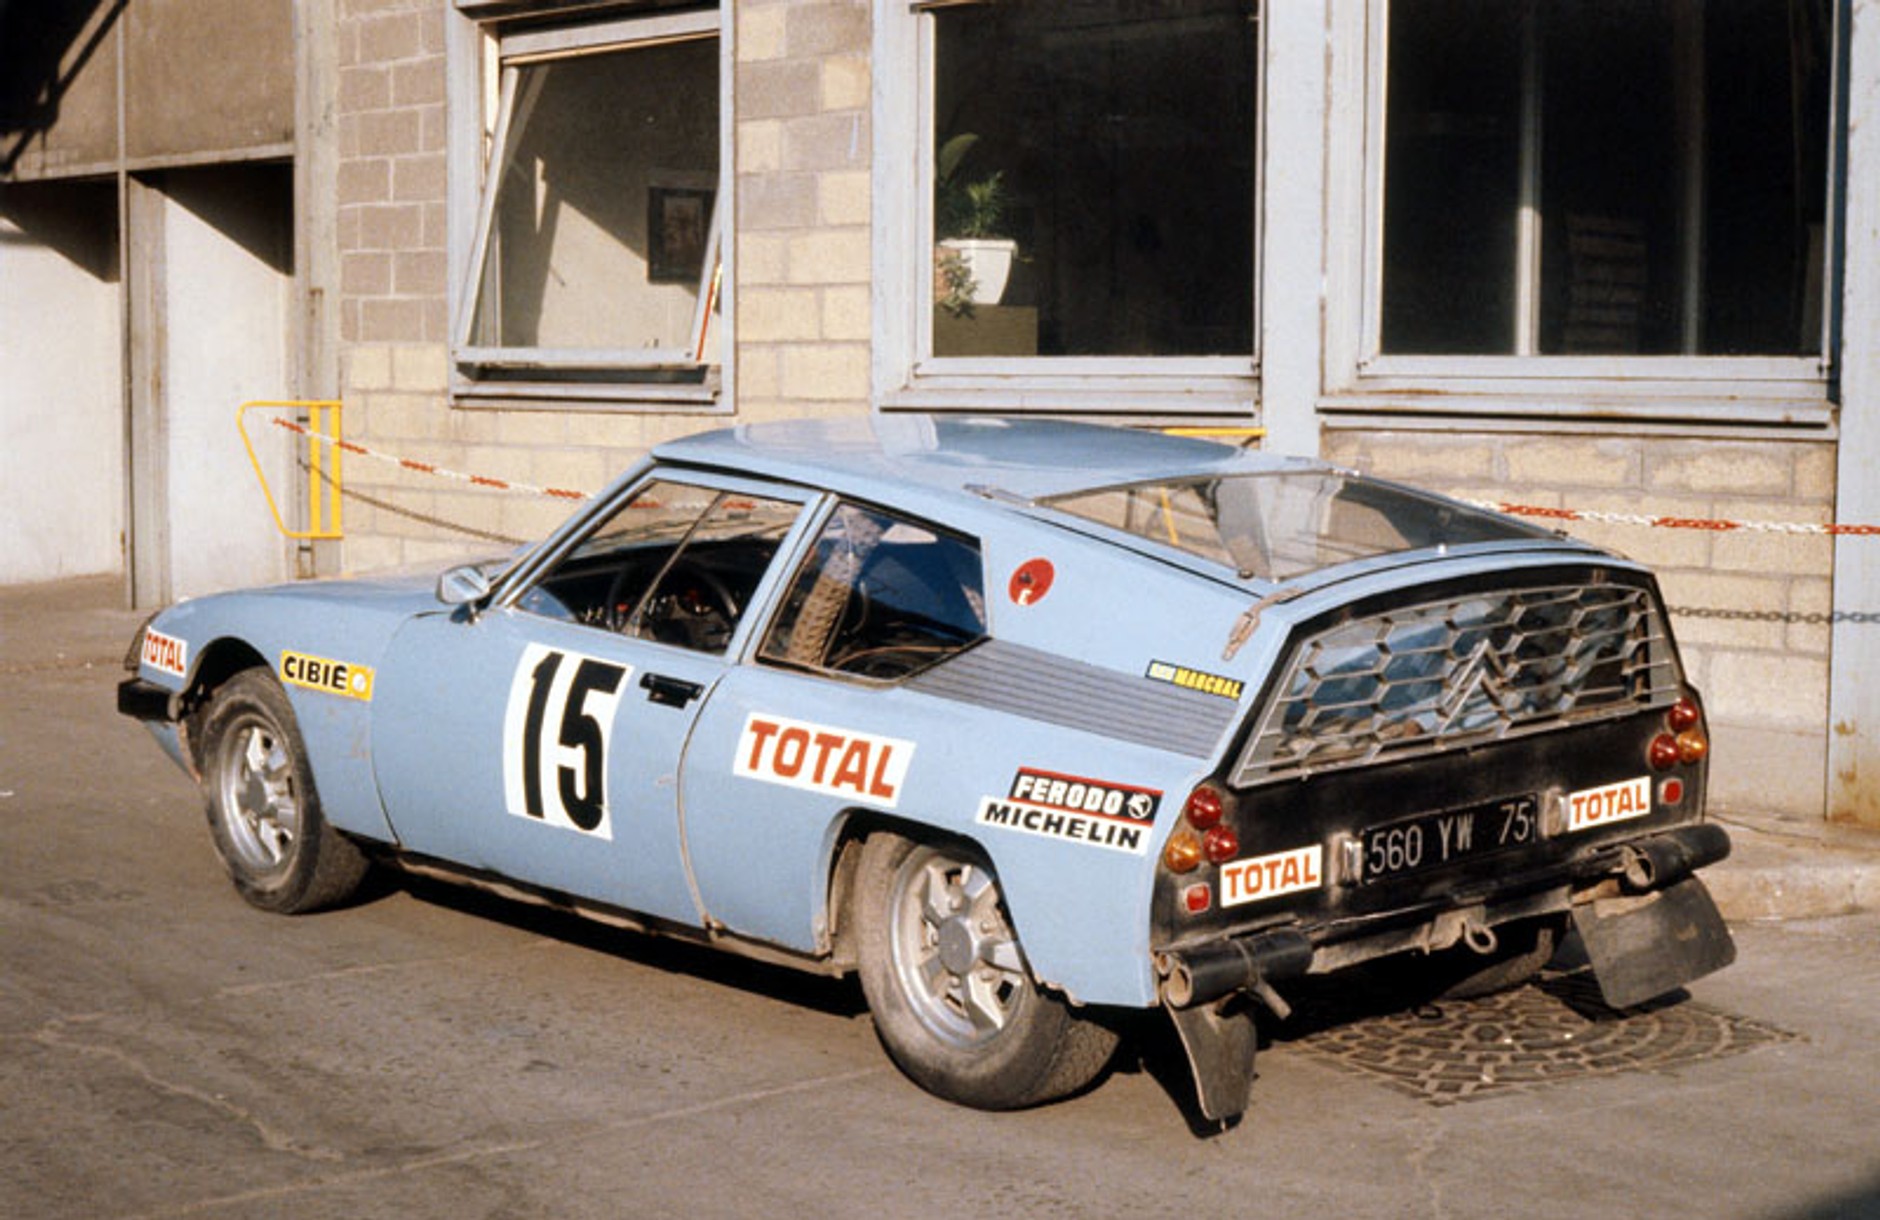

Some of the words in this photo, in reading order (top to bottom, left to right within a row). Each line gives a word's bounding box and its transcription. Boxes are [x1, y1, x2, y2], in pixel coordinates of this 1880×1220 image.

[144, 633, 184, 672] TOTAL
[522, 651, 627, 831] 15
[748, 720, 895, 798] TOTAL
[1013, 774, 1124, 815] FERODO
[1572, 783, 1647, 825] TOTAL
[985, 802, 1141, 849] MICHELIN
[1369, 824, 1423, 874] 560
[1438, 813, 1474, 861] YW
[1499, 801, 1532, 844] 75
[1225, 853, 1318, 898] TOTAL
